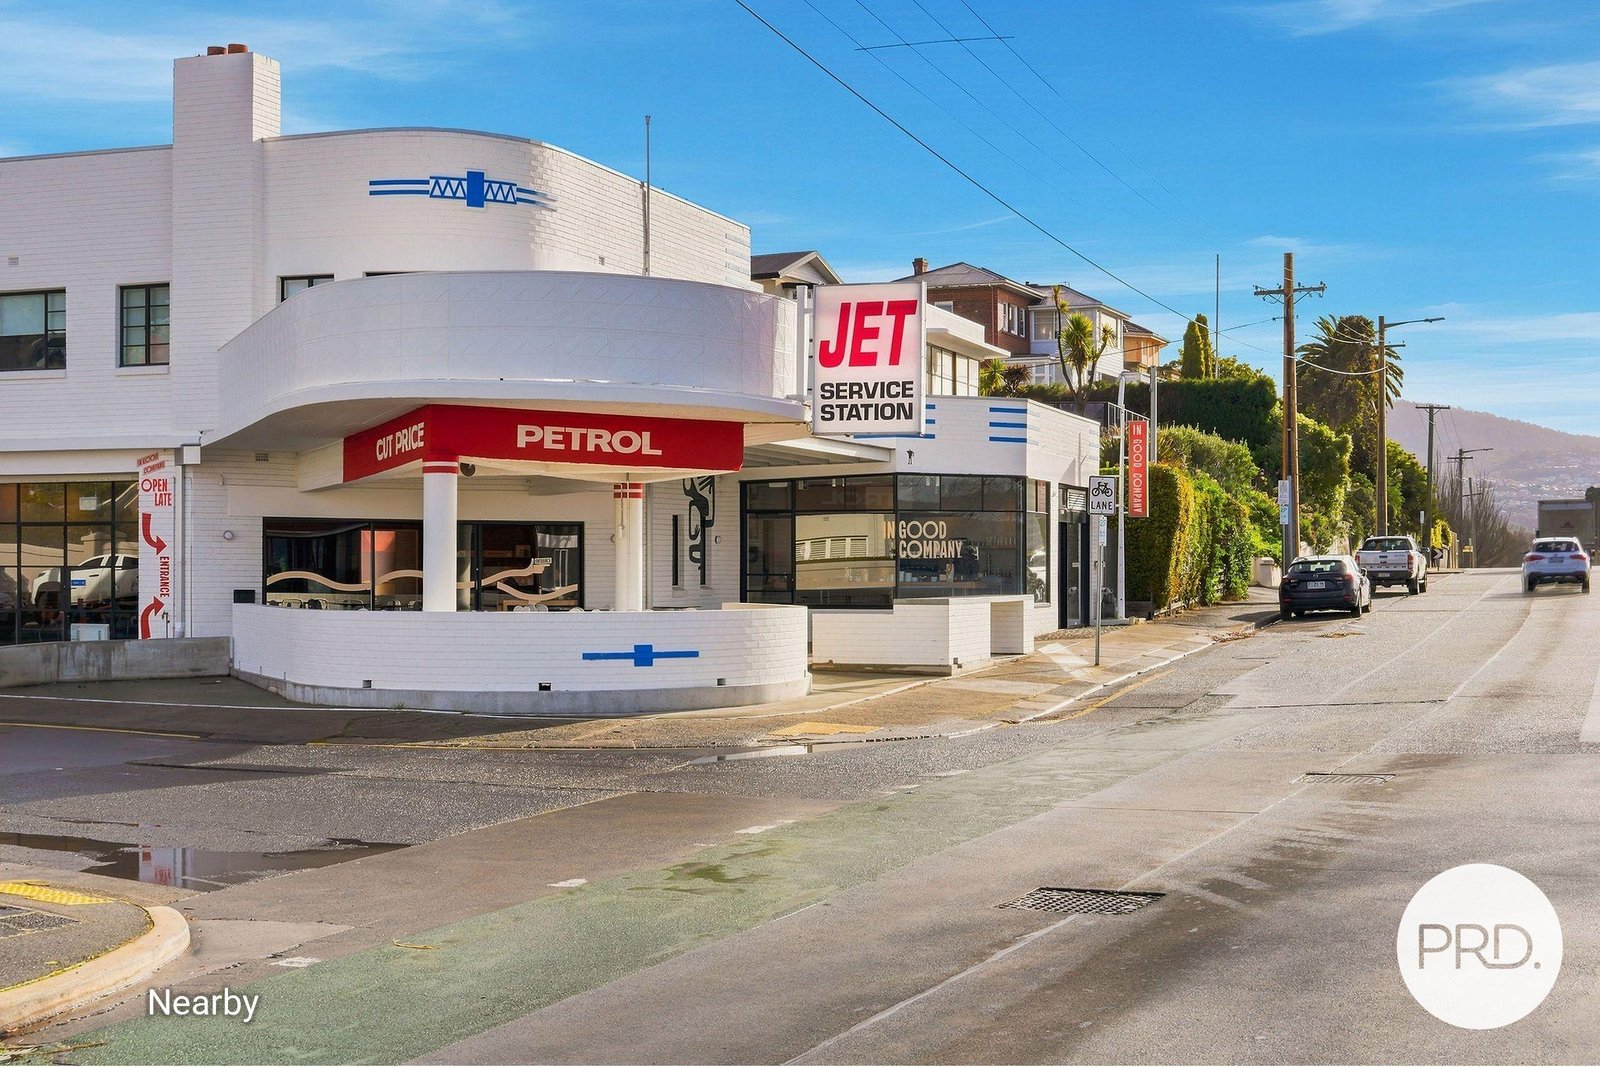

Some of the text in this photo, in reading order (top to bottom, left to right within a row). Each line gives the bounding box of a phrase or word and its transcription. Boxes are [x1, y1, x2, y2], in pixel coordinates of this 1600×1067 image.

[818, 299, 918, 368] JET
[820, 380, 914, 400] SERVICE
[820, 402, 914, 421] STATION
[376, 421, 425, 462] CUT PRICE
[516, 424, 663, 456] PETROL
[1133, 425, 1142, 513] IN GOOD COMPANY
[141, 478, 168, 493] OPEN
[154, 493, 172, 506] LATE
[1090, 501, 1113, 511] LANE
[884, 520, 947, 539] IN GOOD
[899, 540, 963, 559] COMPANY
[159, 556, 170, 598] ENTRANCE
